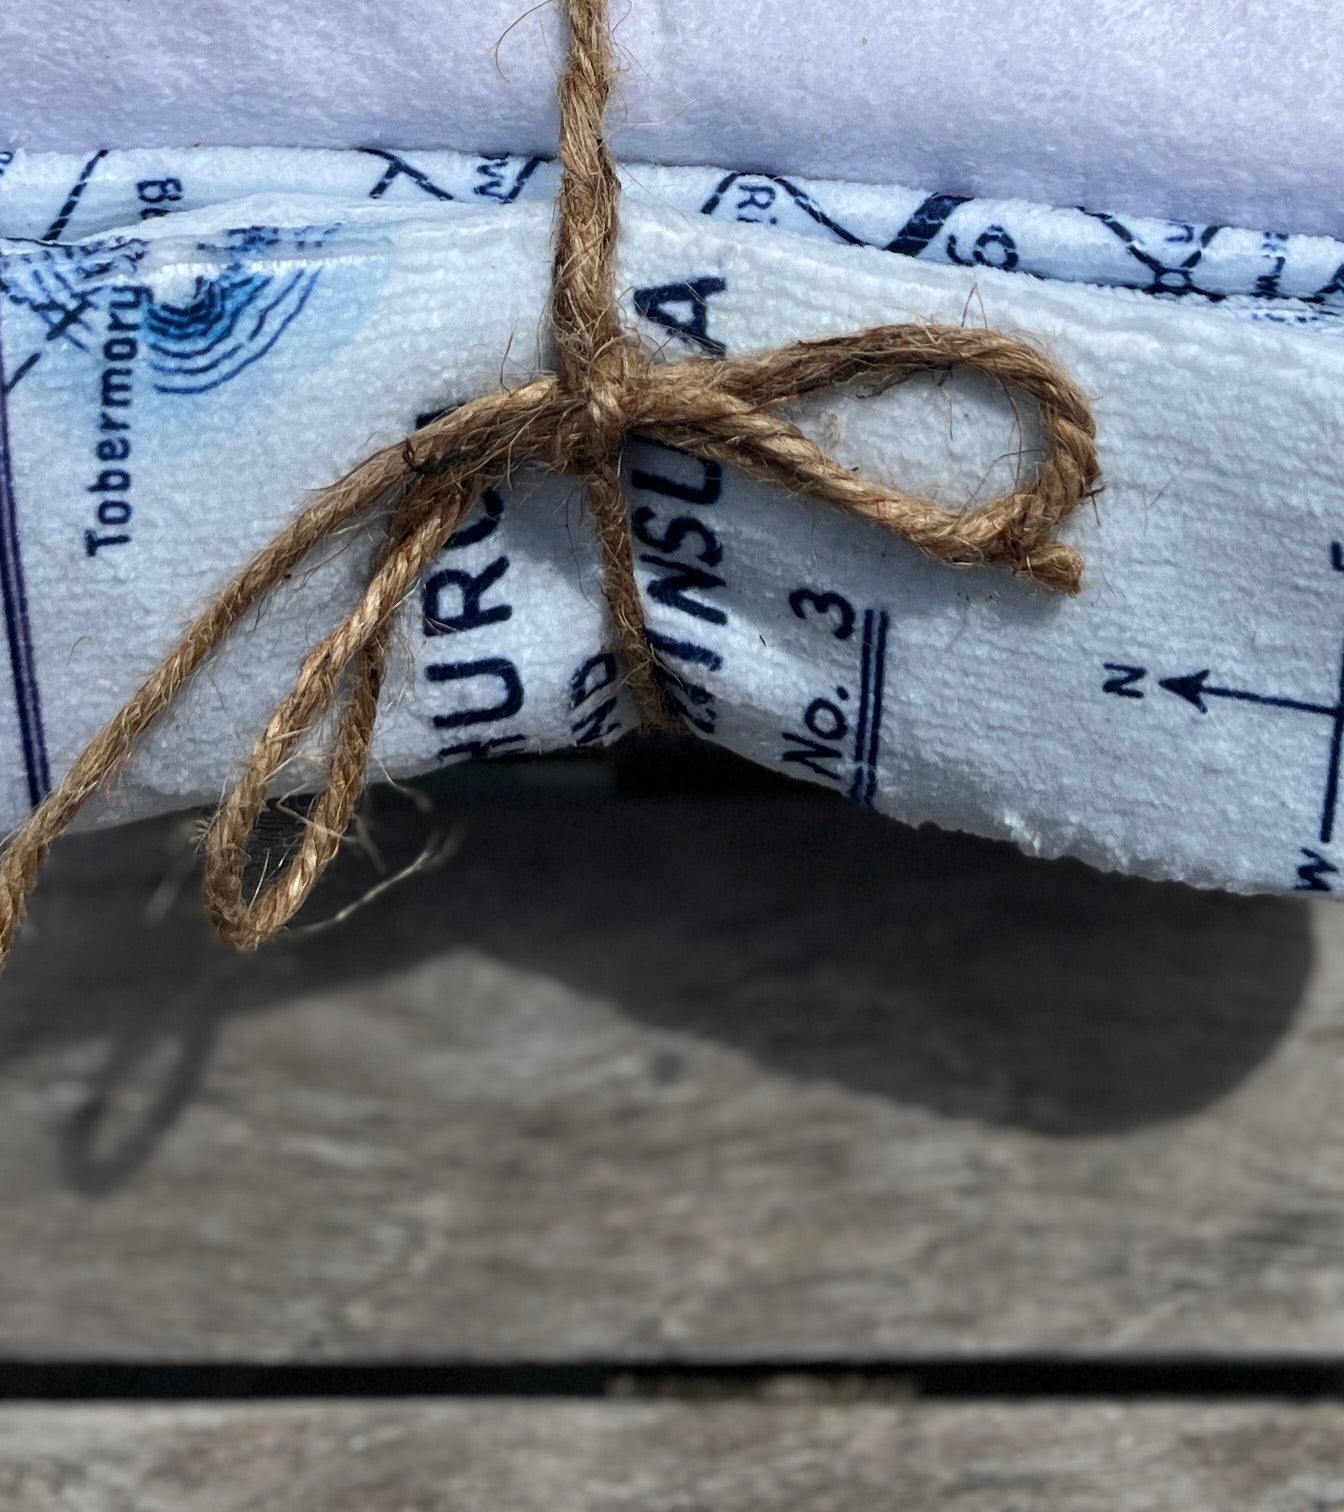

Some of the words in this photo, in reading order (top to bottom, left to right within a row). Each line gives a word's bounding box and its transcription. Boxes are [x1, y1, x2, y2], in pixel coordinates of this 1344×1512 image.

[83, 285, 142, 558] Tobermory
[788, 587, 857, 640] 3
[781, 684, 852, 781] No.
